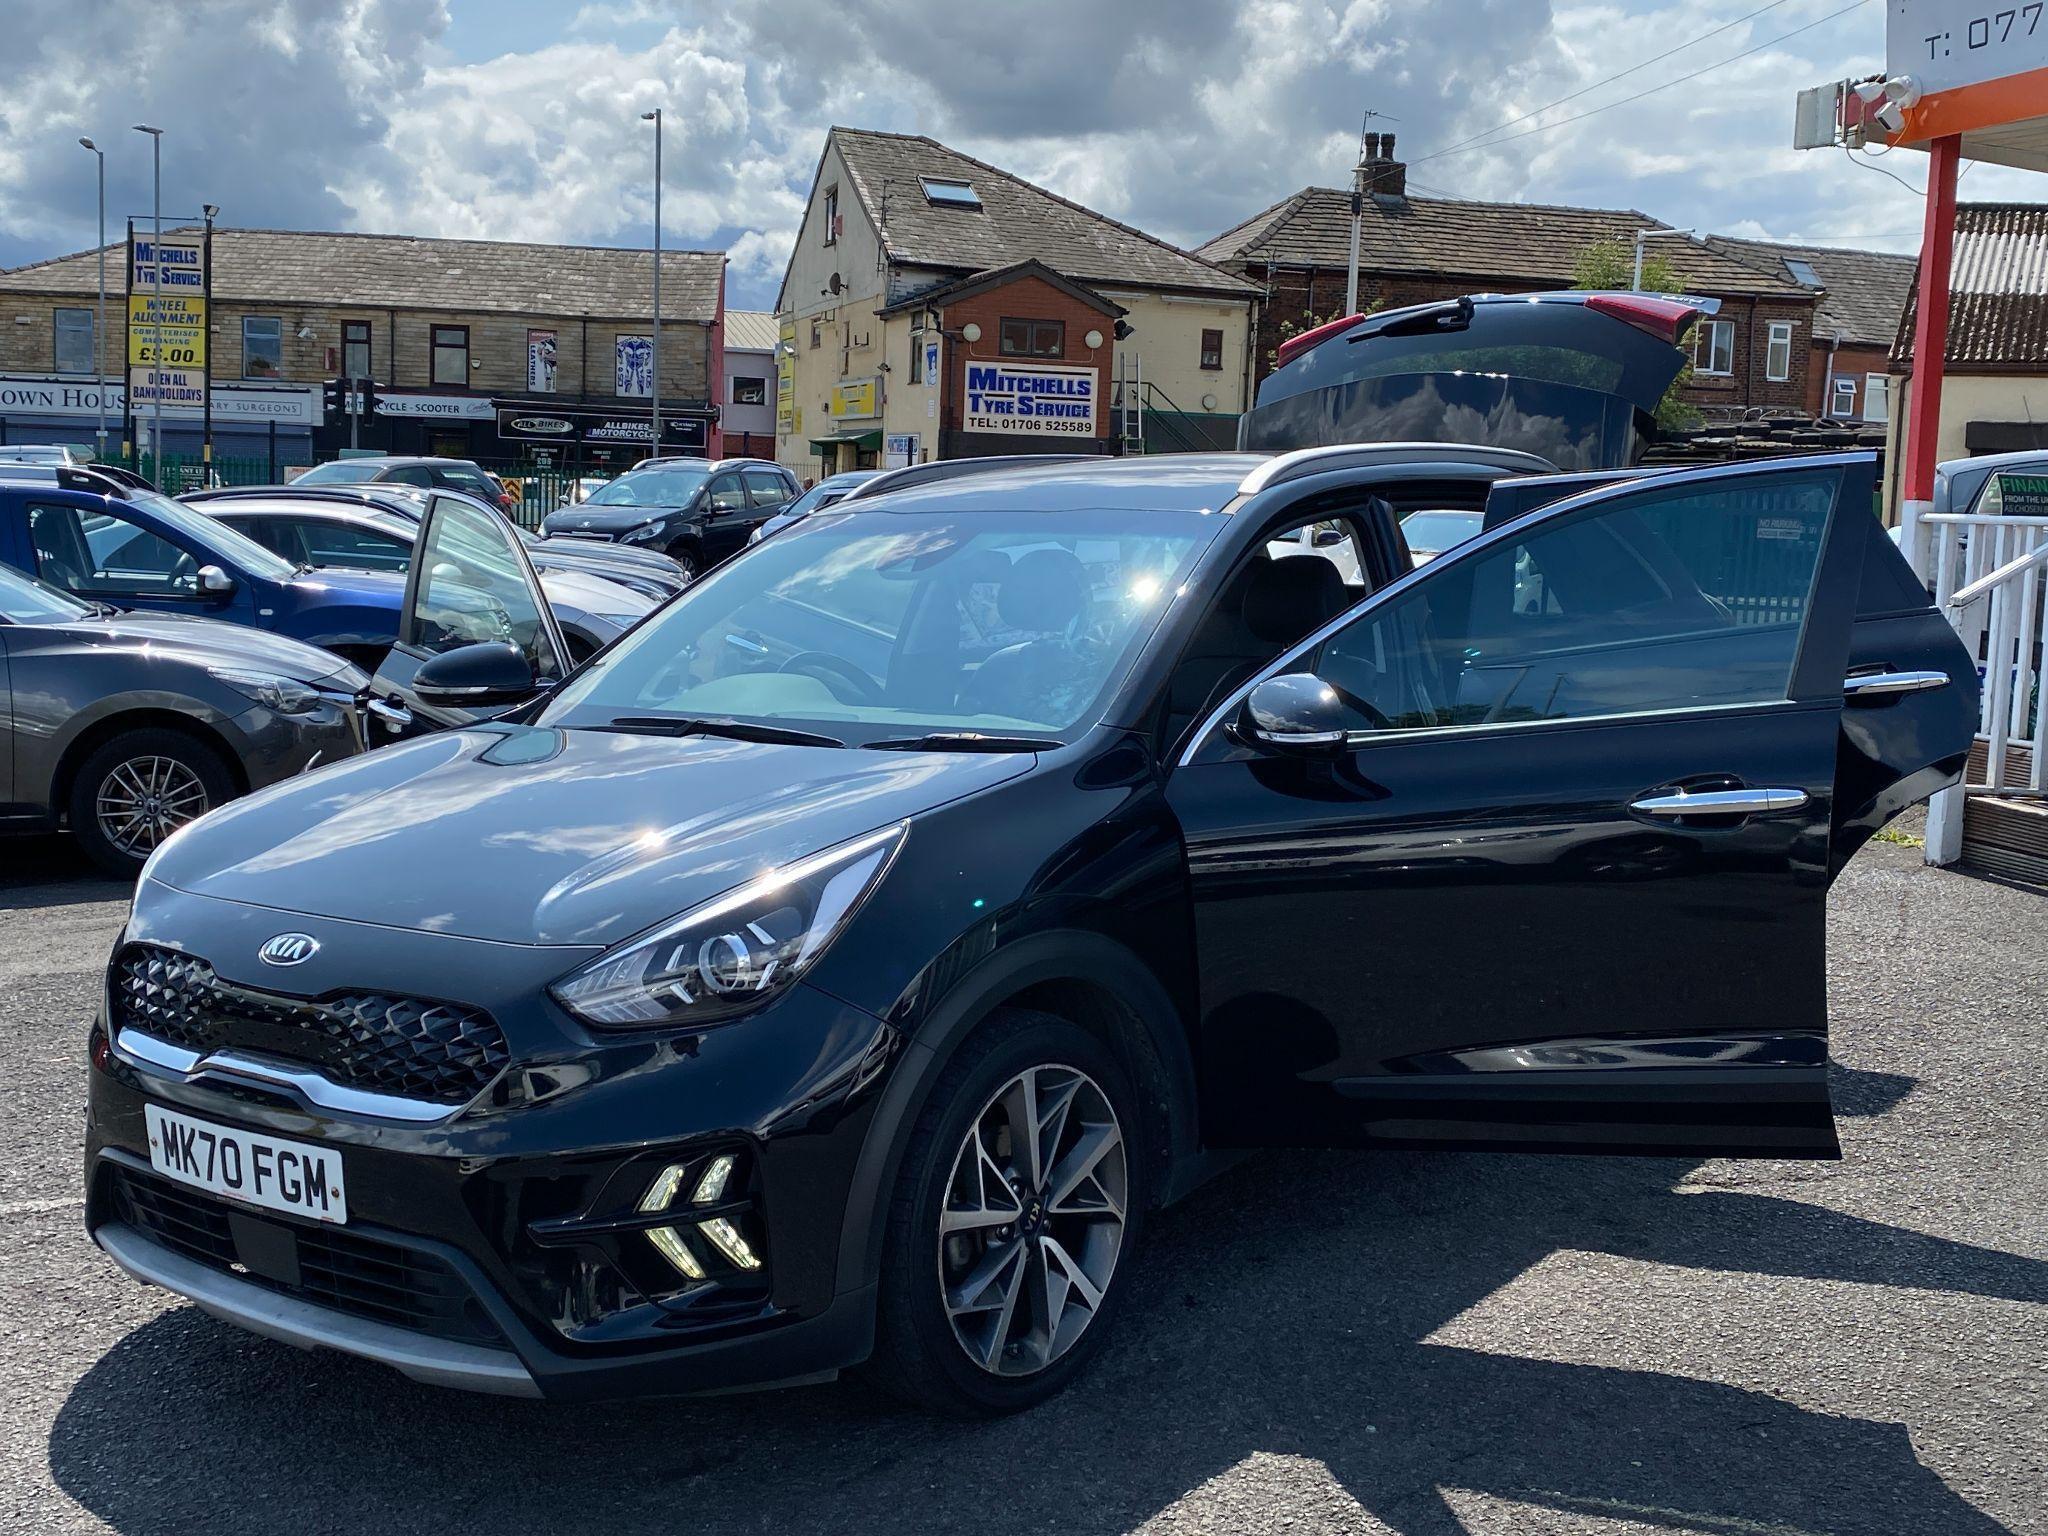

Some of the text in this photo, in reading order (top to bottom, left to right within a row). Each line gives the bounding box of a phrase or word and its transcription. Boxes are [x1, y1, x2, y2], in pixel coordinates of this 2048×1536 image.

[1925, 2, 2043, 59] T: 077
[136, 242, 197, 264] MICHELLS
[136, 266, 201, 285] TYR SERVICE
[148, 373, 187, 386] OEN ALL
[968, 367, 1092, 396] MITCHELLS
[159, 387, 202, 401] HOLIDAYS
[236, 403, 298, 413] SURGEONS
[415, 403, 460, 413] SCOOTER
[969, 393, 1091, 418] TYRE SERVICE
[538, 421, 566, 429] BIKES
[604, 421, 650, 431] ALLBIKES
[969, 417, 1092, 432] TEL: 01706 525589
[2004, 494, 2024, 503] FROM
[2026, 496, 2040, 504] THE
[2004, 505, 2013, 513] AS
[2015, 504, 2043, 513] CHOSEN
[265, 937, 307, 960] KIA
[160, 1117, 329, 1211] MK70 FGM
